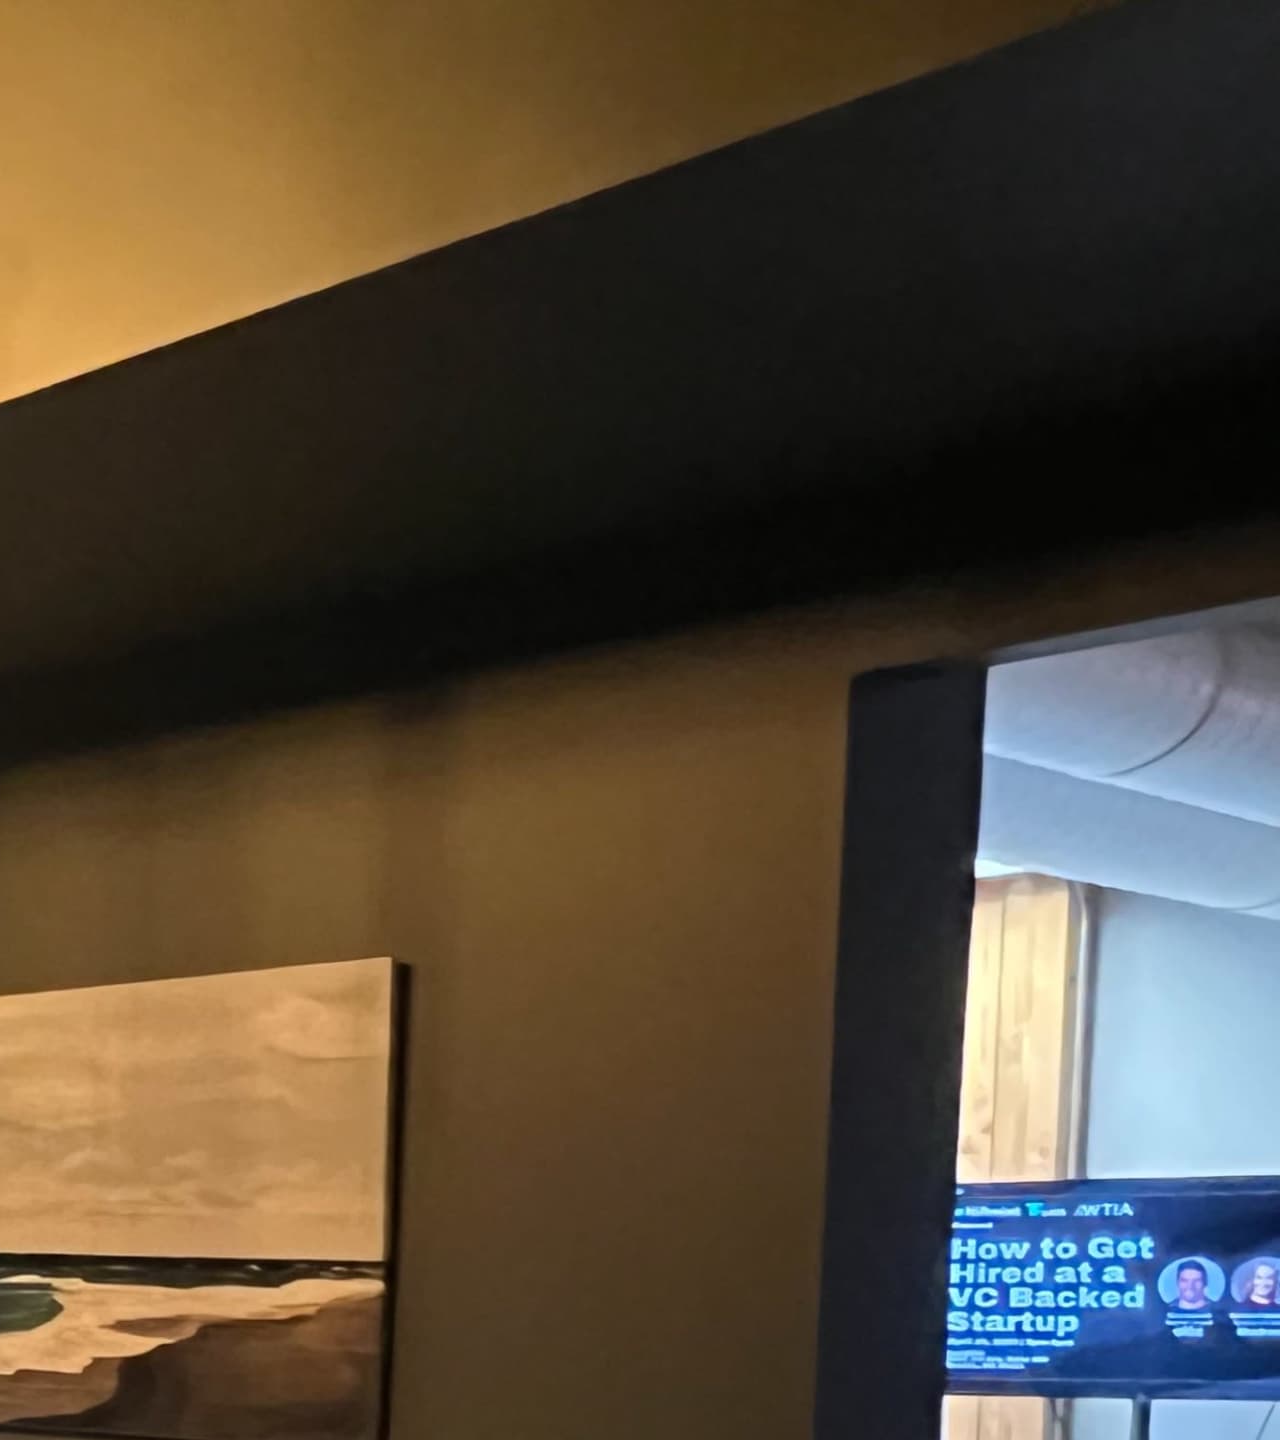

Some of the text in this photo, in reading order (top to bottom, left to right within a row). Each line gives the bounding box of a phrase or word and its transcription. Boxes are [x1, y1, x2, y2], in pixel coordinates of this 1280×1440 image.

[951, 1235, 1155, 1260] How to Get
[949, 1261, 1126, 1284] Hired at a
[948, 1283, 1145, 1308] VC Backed
[947, 1311, 1080, 1337] Startup
